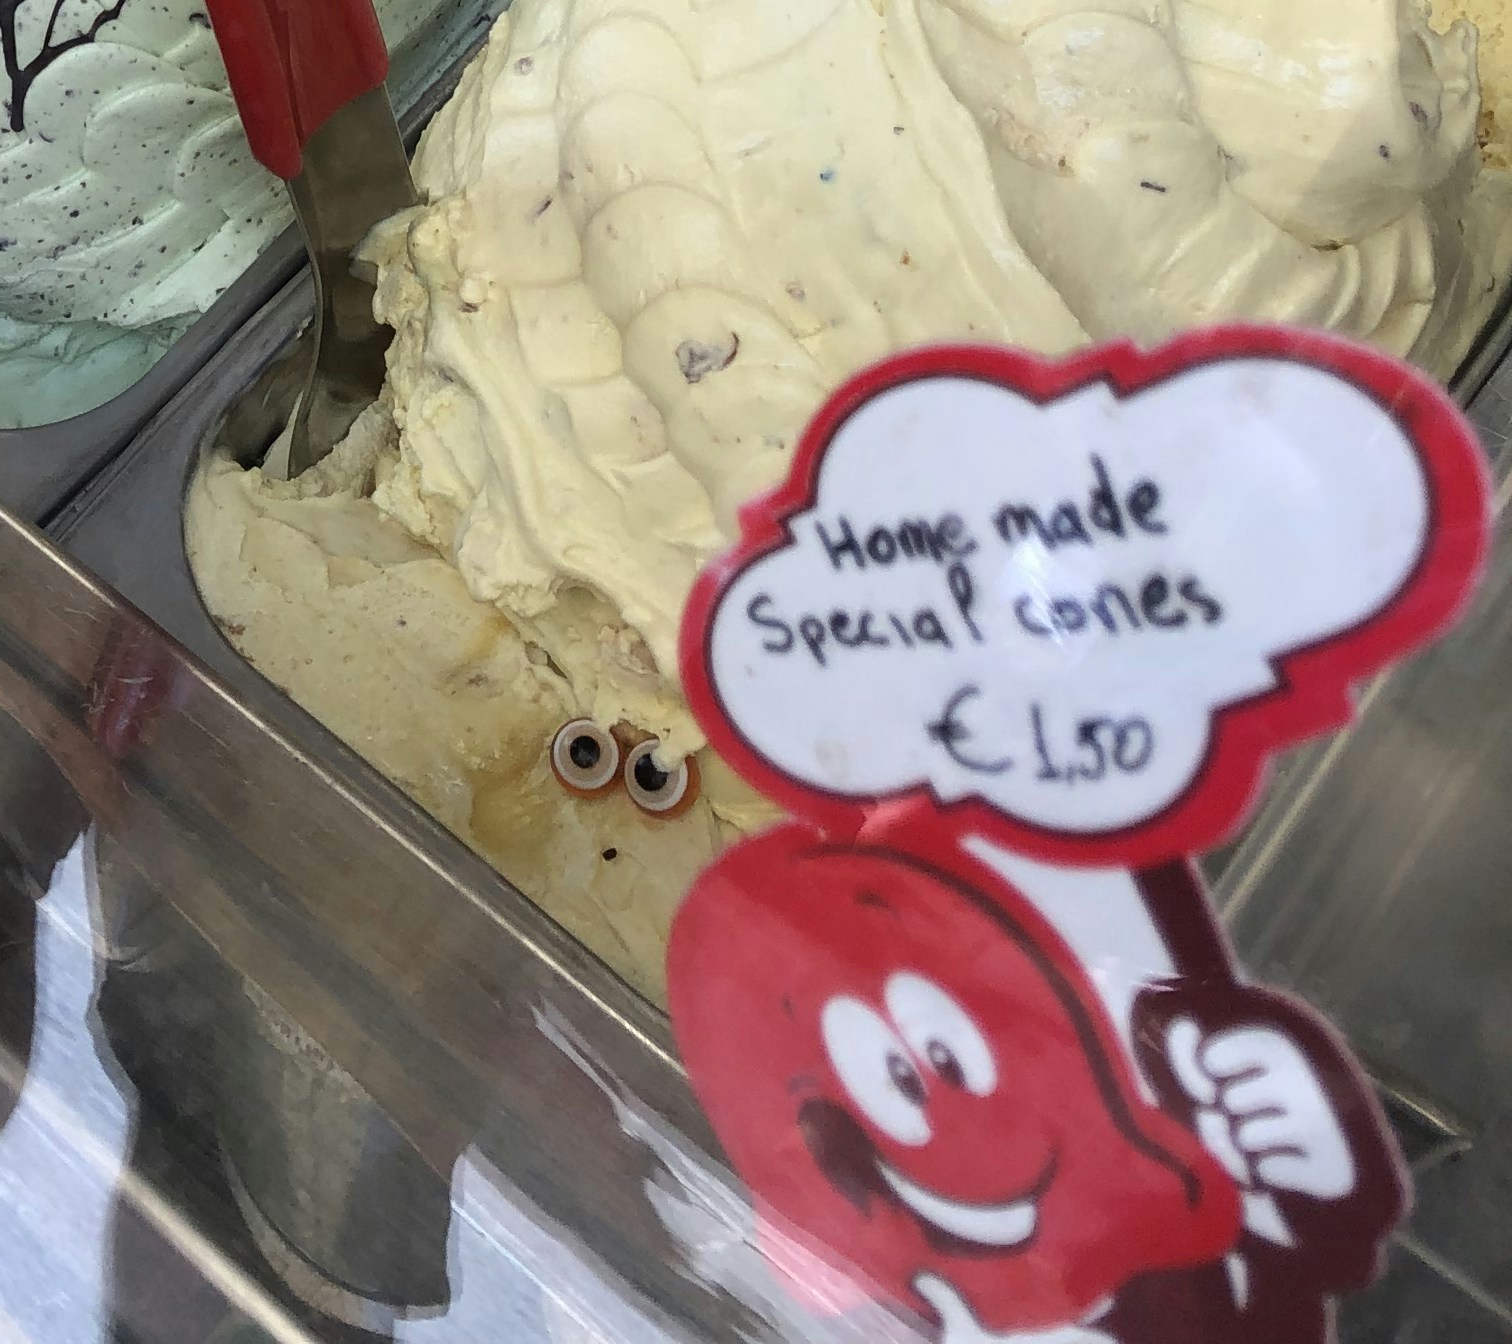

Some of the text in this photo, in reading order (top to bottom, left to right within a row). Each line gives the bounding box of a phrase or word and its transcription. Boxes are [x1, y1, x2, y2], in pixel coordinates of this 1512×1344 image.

[999, 452, 1170, 550] made
[747, 565, 1225, 666] Special cones
[1029, 701, 1156, 792] 1,50
